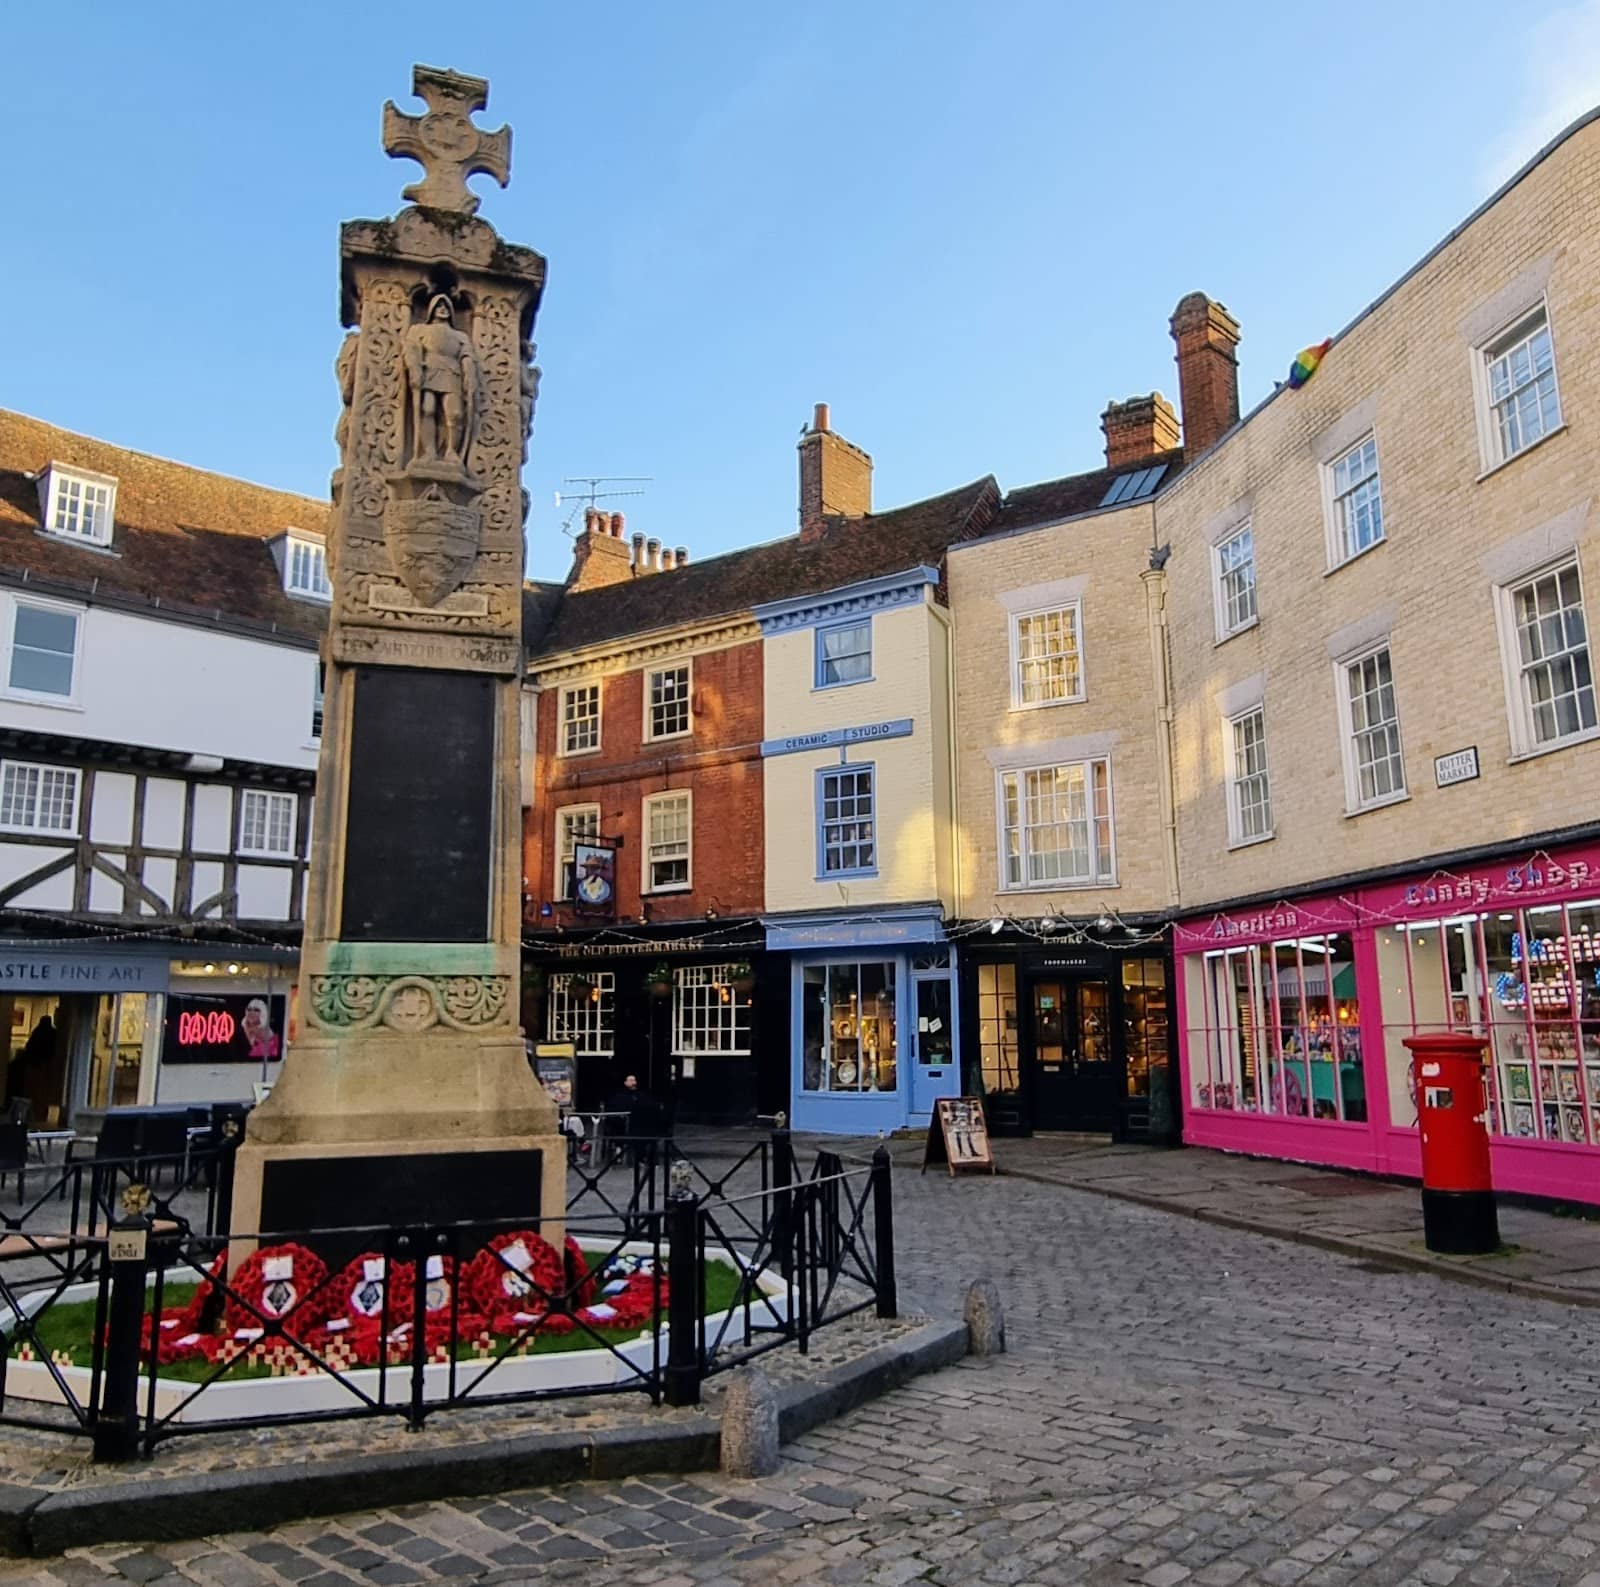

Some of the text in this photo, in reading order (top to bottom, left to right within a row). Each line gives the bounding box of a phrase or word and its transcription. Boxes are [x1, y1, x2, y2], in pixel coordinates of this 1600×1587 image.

[785, 724, 889, 748] CERAMIC STUDIO
[1439, 764, 1473, 781] MARKET
[1440, 753, 1471, 771] BUTTER
[1405, 874, 1490, 906] Candy
[1215, 911, 1297, 938] American
[0, 963, 145, 980] STLE FINE ART
